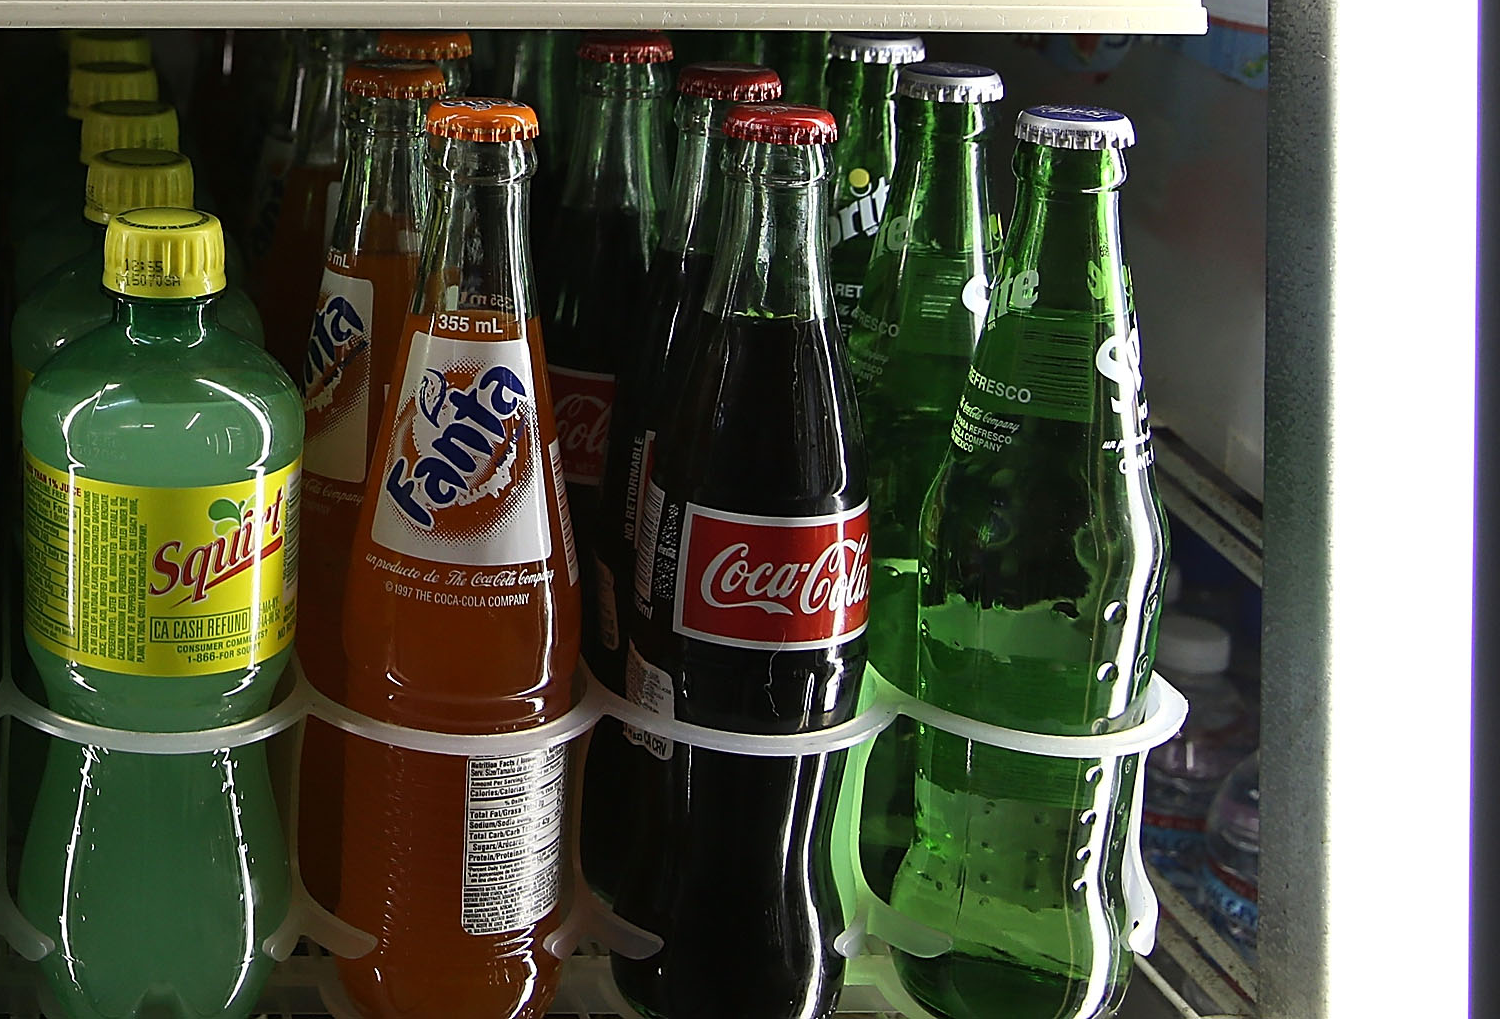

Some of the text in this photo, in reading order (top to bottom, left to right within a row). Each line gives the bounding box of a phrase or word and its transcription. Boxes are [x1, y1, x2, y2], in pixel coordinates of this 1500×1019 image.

[438, 314, 504, 334] 355 mL
[982, 411, 1021, 434] Company
[964, 432, 1002, 453] COMPANY
[969, 424, 1012, 445] REFRESCO
[387, 365, 528, 530] Fanta
[52, 490, 68, 502] FREE
[624, 436, 646, 541] NO RETORNABLE
[150, 485, 284, 603] Squirt
[366, 552, 376, 564] un
[374, 558, 421, 580] producto
[423, 568, 440, 584] de
[444, 569, 468, 587] The
[700, 532, 869, 616] Coca-Cola
[415, 588, 530, 608] THE COCA-COLA COMPANY
[154, 620, 170, 639] CA
[173, 617, 204, 639] CASH
[208, 612, 248, 636] REFUND
[176, 642, 224, 654] CONSUMER
[188, 648, 234, 663] 1-866-FOR
[643, 731, 652, 748] CA
[652, 737, 668, 757] CRV
[470, 759, 515, 769] Nutrition Facts
[470, 806, 522, 819] Total Fat/Grasa
[469, 828, 521, 840] Total Carb/Carb
